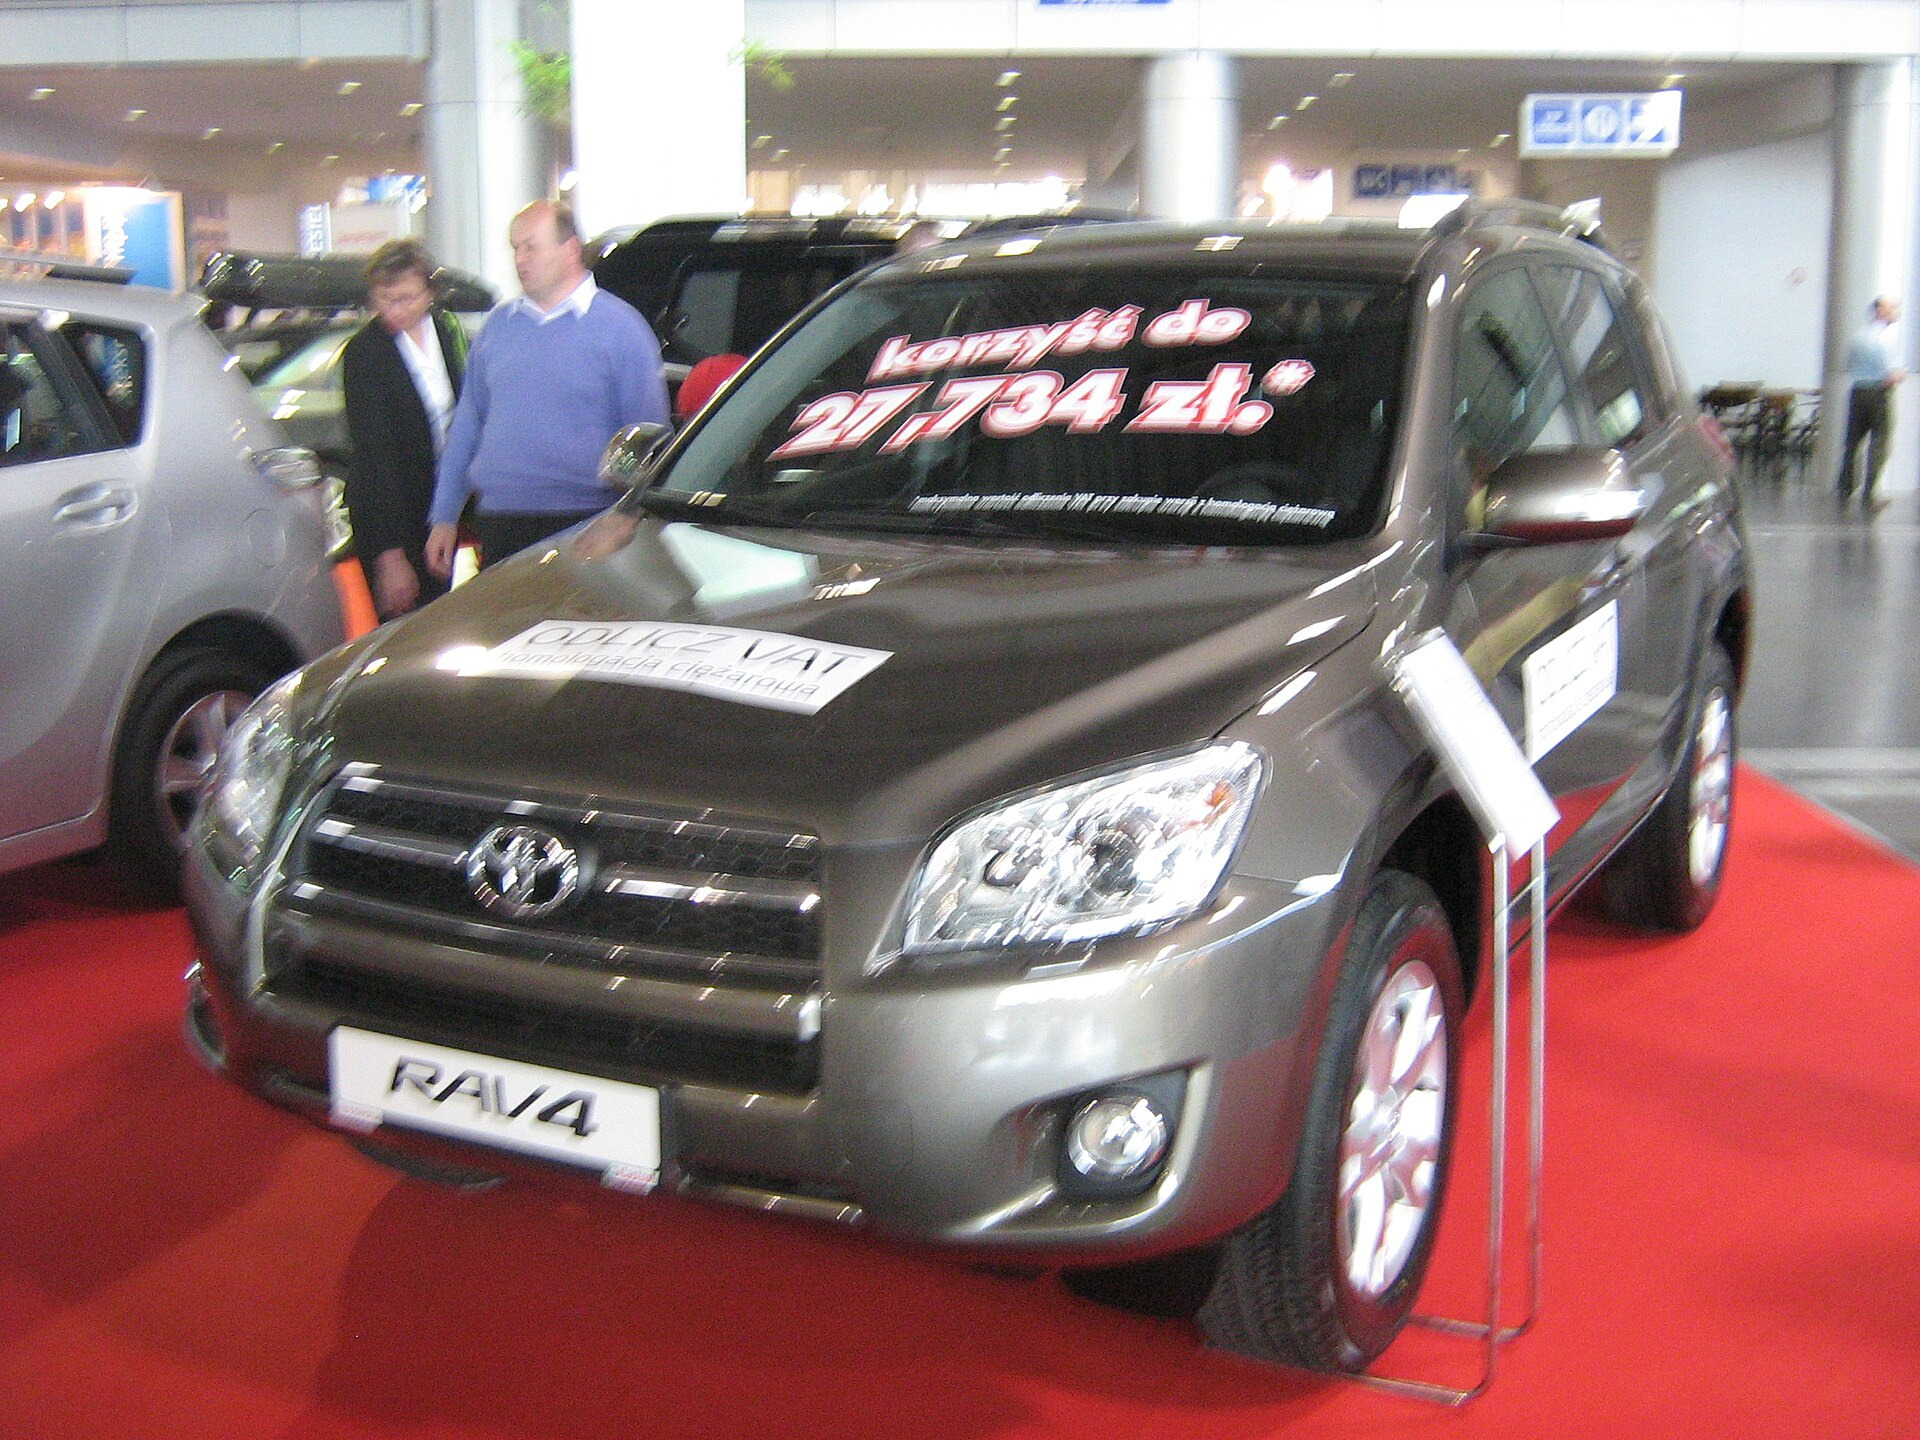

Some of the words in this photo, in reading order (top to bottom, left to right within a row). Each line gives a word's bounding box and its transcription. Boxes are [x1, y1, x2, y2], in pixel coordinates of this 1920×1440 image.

[864, 303, 1145, 384] korzyść
[1142, 298, 1252, 348] do
[501, 650, 663, 670] homologacja
[528, 626, 738, 653] ODLICZ
[742, 638, 866, 675] VAT
[391, 1055, 599, 1137] RAV4
